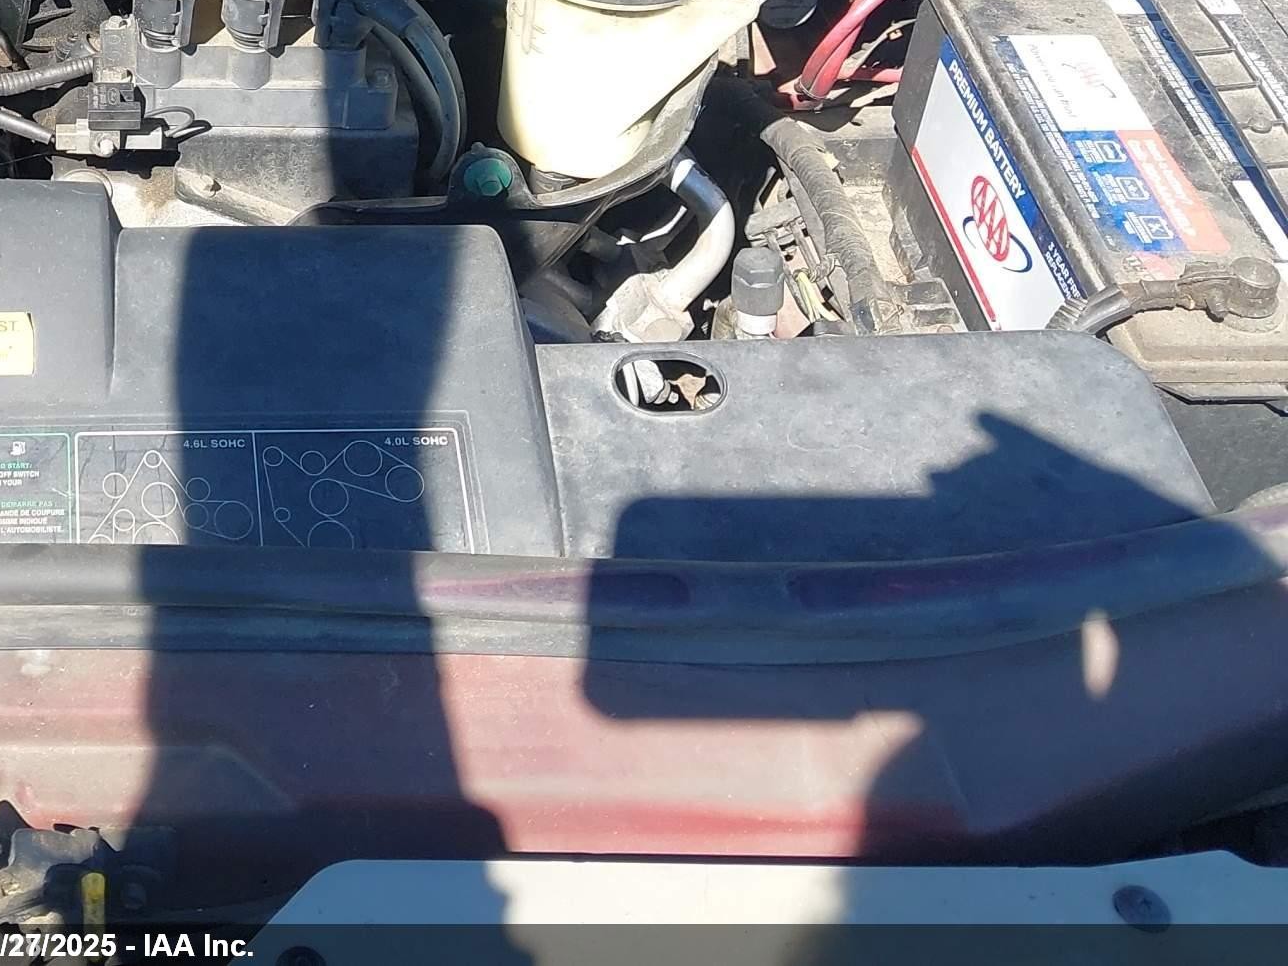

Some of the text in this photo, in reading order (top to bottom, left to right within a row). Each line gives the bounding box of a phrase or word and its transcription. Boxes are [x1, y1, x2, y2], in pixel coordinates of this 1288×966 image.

[948, 59, 1026, 200] PREMIUM BATTERY
[1053, 248, 1070, 280] YEAR
[183, 438, 246, 449] 4.6L SOHC
[384, 436, 448, 446] 4.0L SOHC
